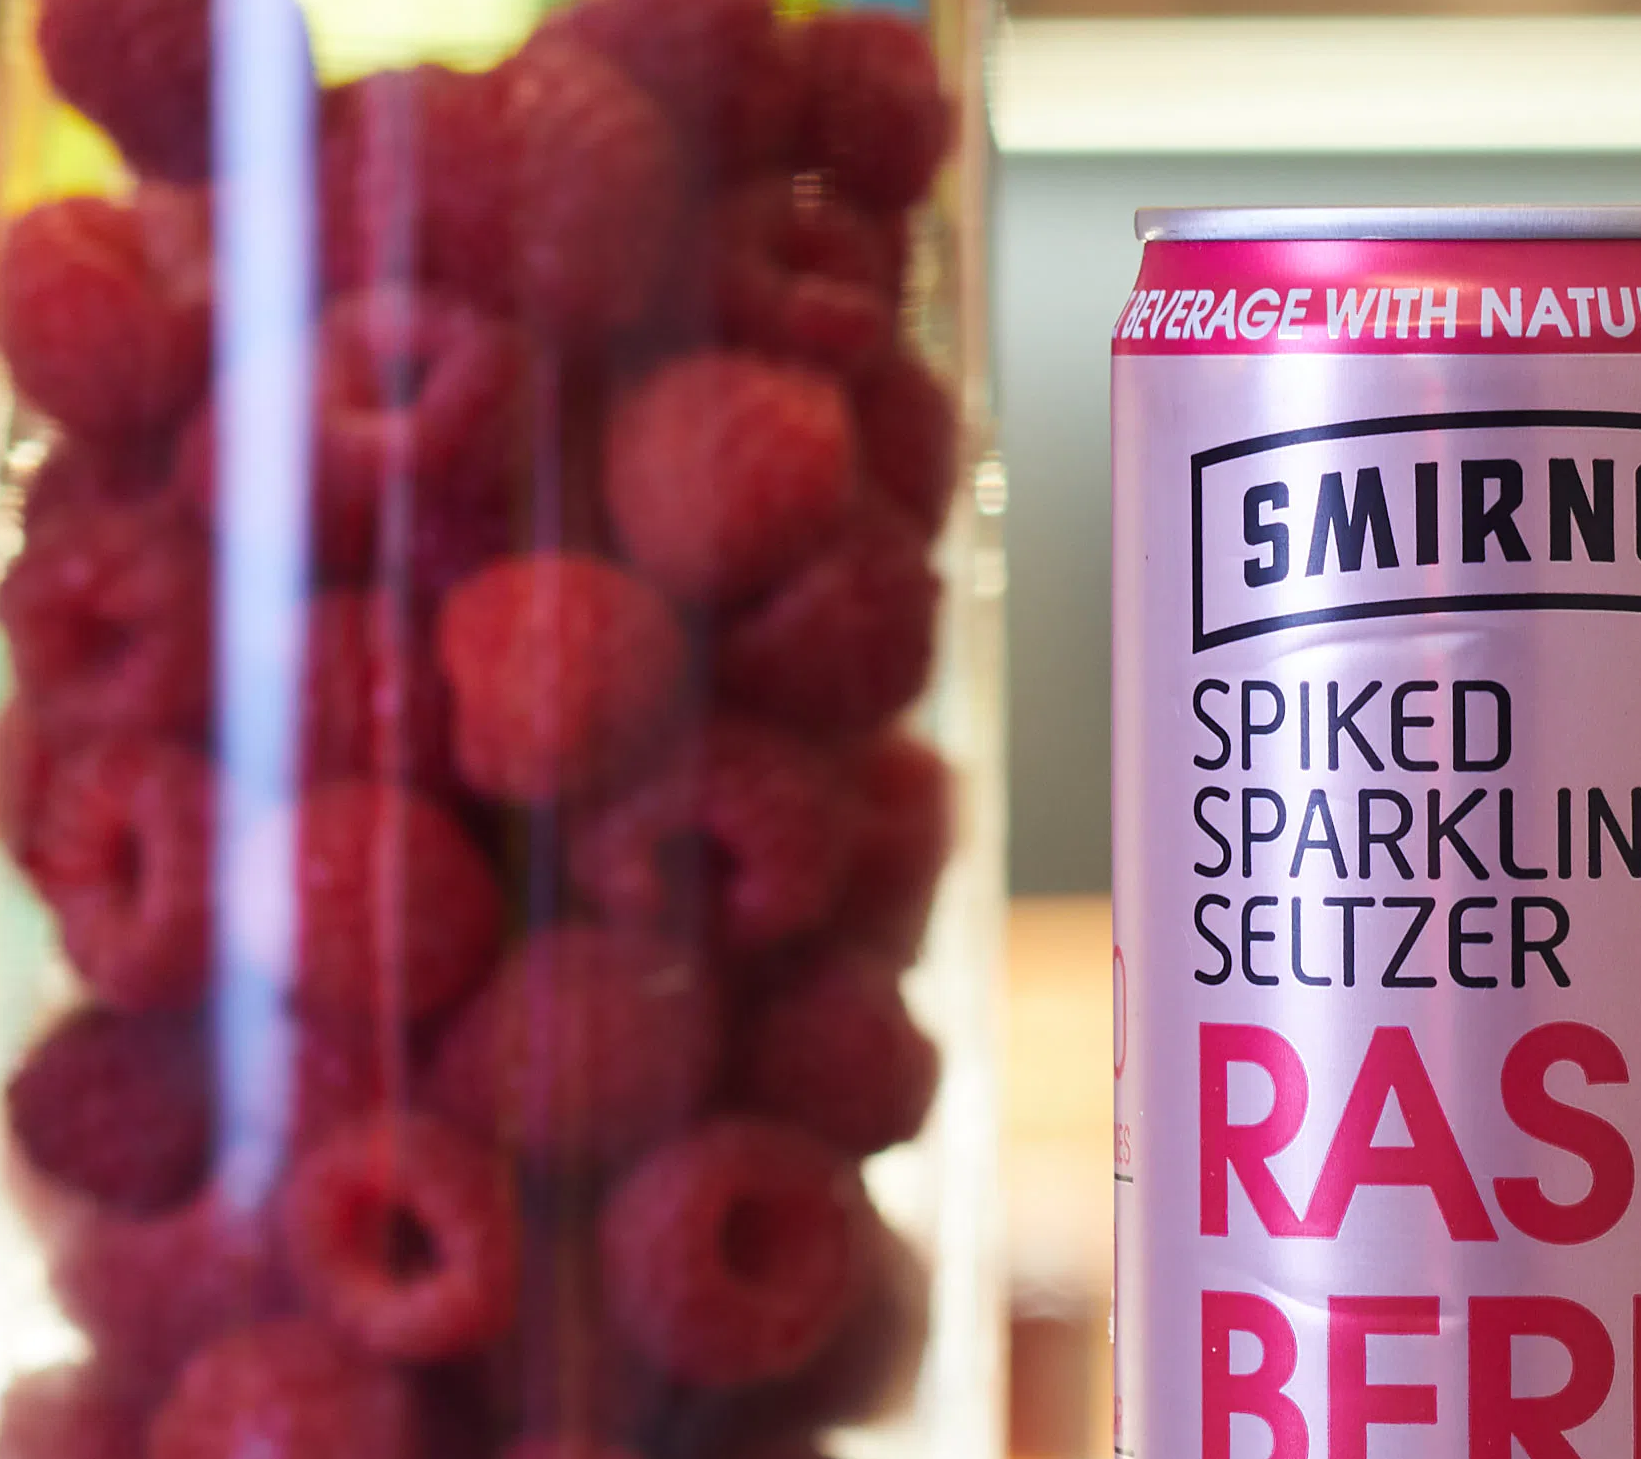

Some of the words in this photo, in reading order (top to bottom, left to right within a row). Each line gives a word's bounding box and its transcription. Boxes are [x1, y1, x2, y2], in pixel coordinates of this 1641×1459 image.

[1120, 287, 1312, 341] BEVERAGE
[1326, 286, 1458, 340] WITH
[1192, 678, 1512, 774] SPIKED
[1192, 895, 1572, 990] SELTZER
